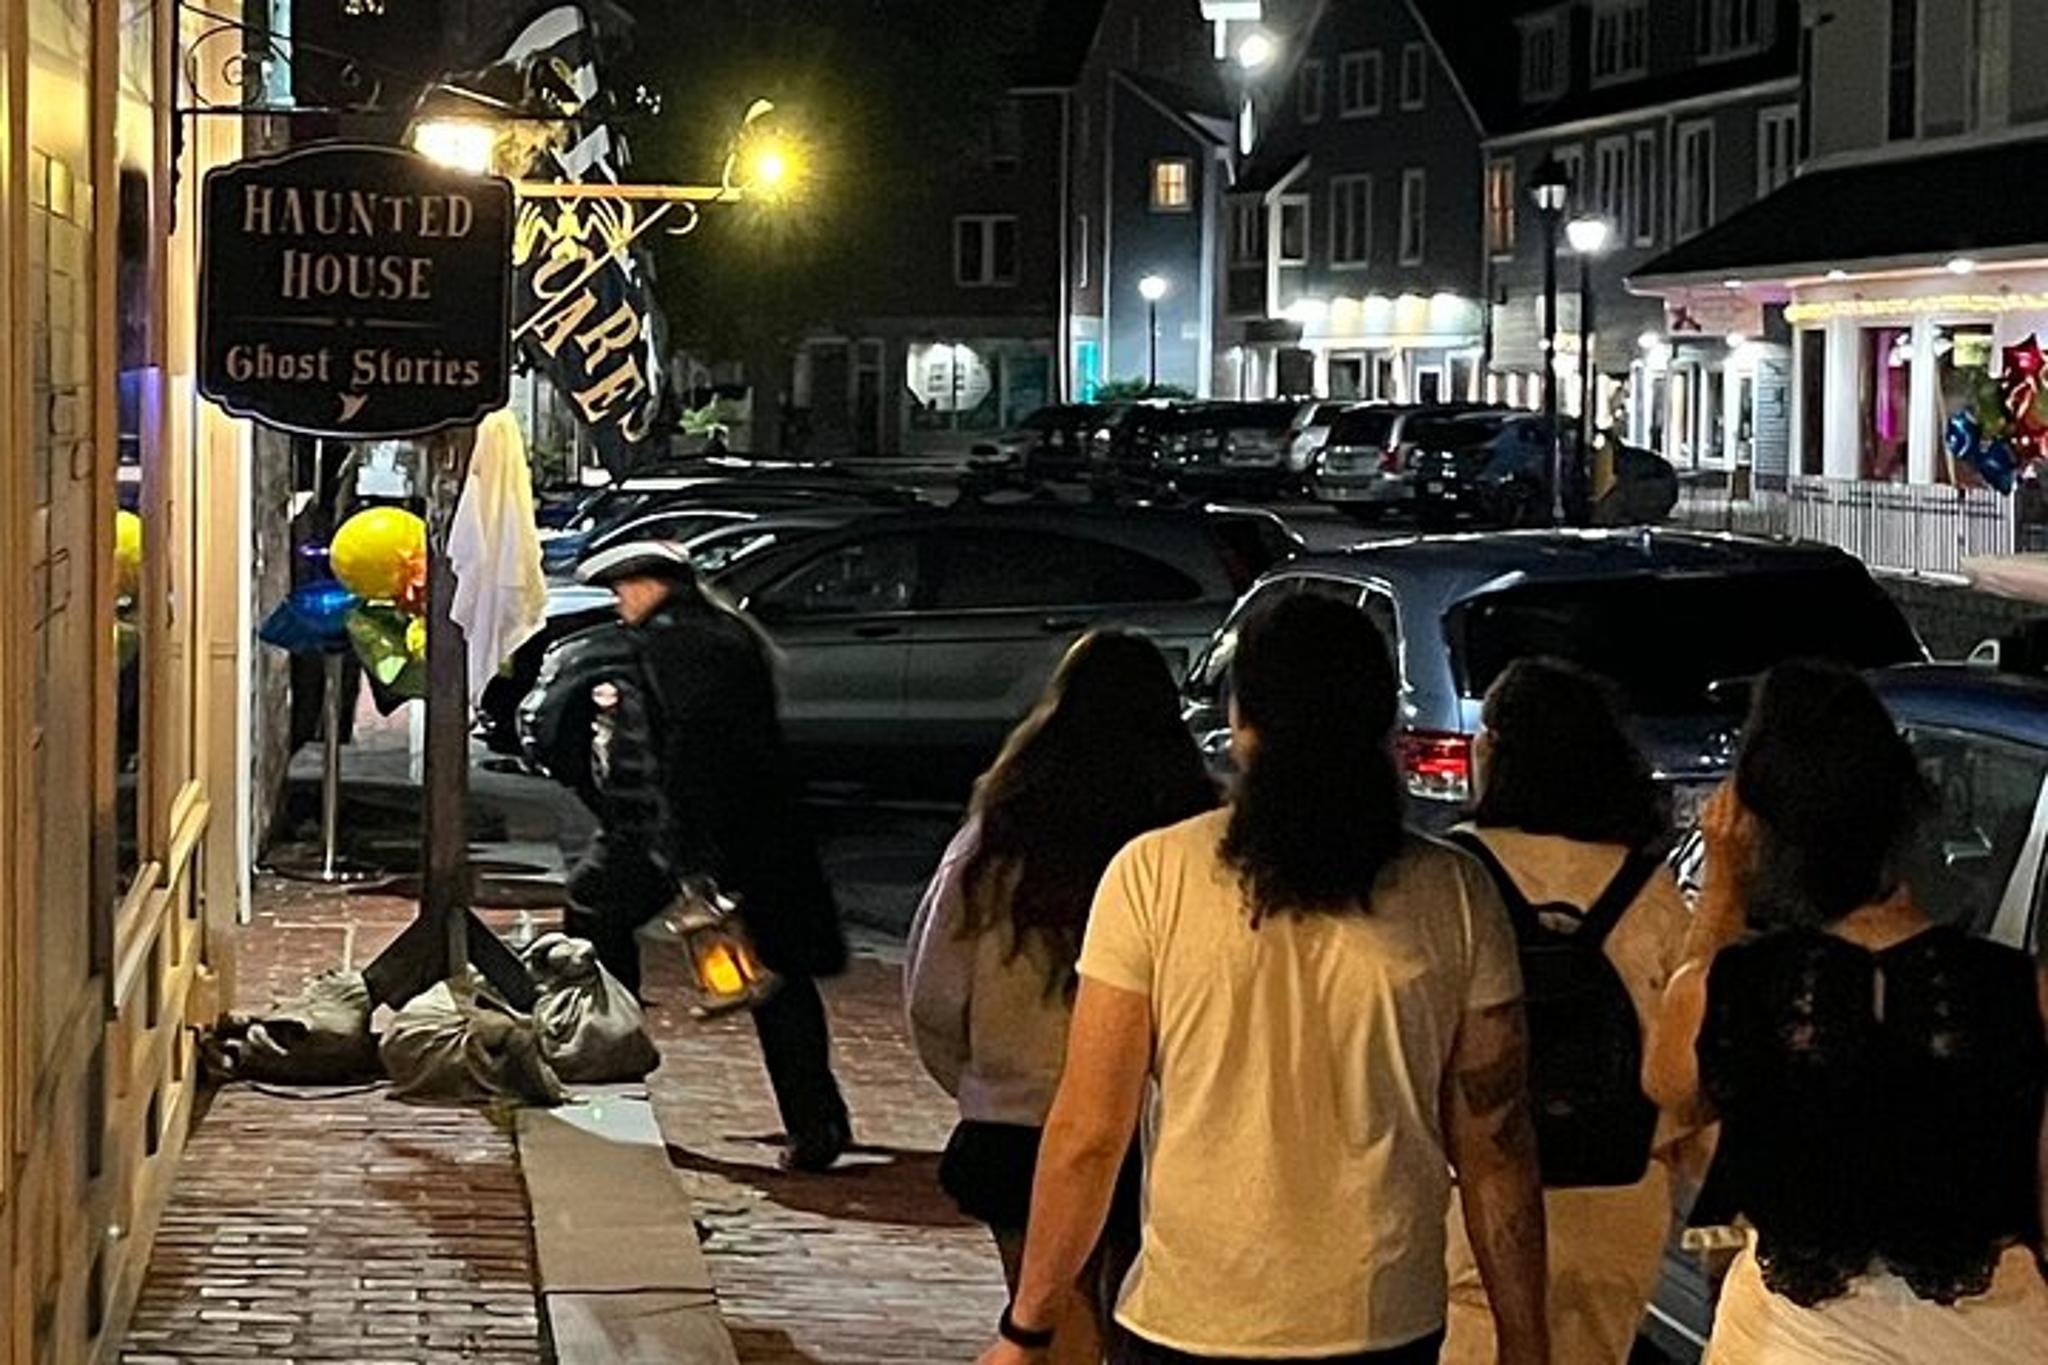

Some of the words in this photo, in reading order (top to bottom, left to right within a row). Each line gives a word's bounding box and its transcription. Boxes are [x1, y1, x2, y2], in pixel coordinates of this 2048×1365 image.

[242, 184, 473, 239] HAUNTED
[281, 255, 433, 300] HOUSE
[226, 345, 330, 384] Ghost
[350, 346, 481, 389] Stories
